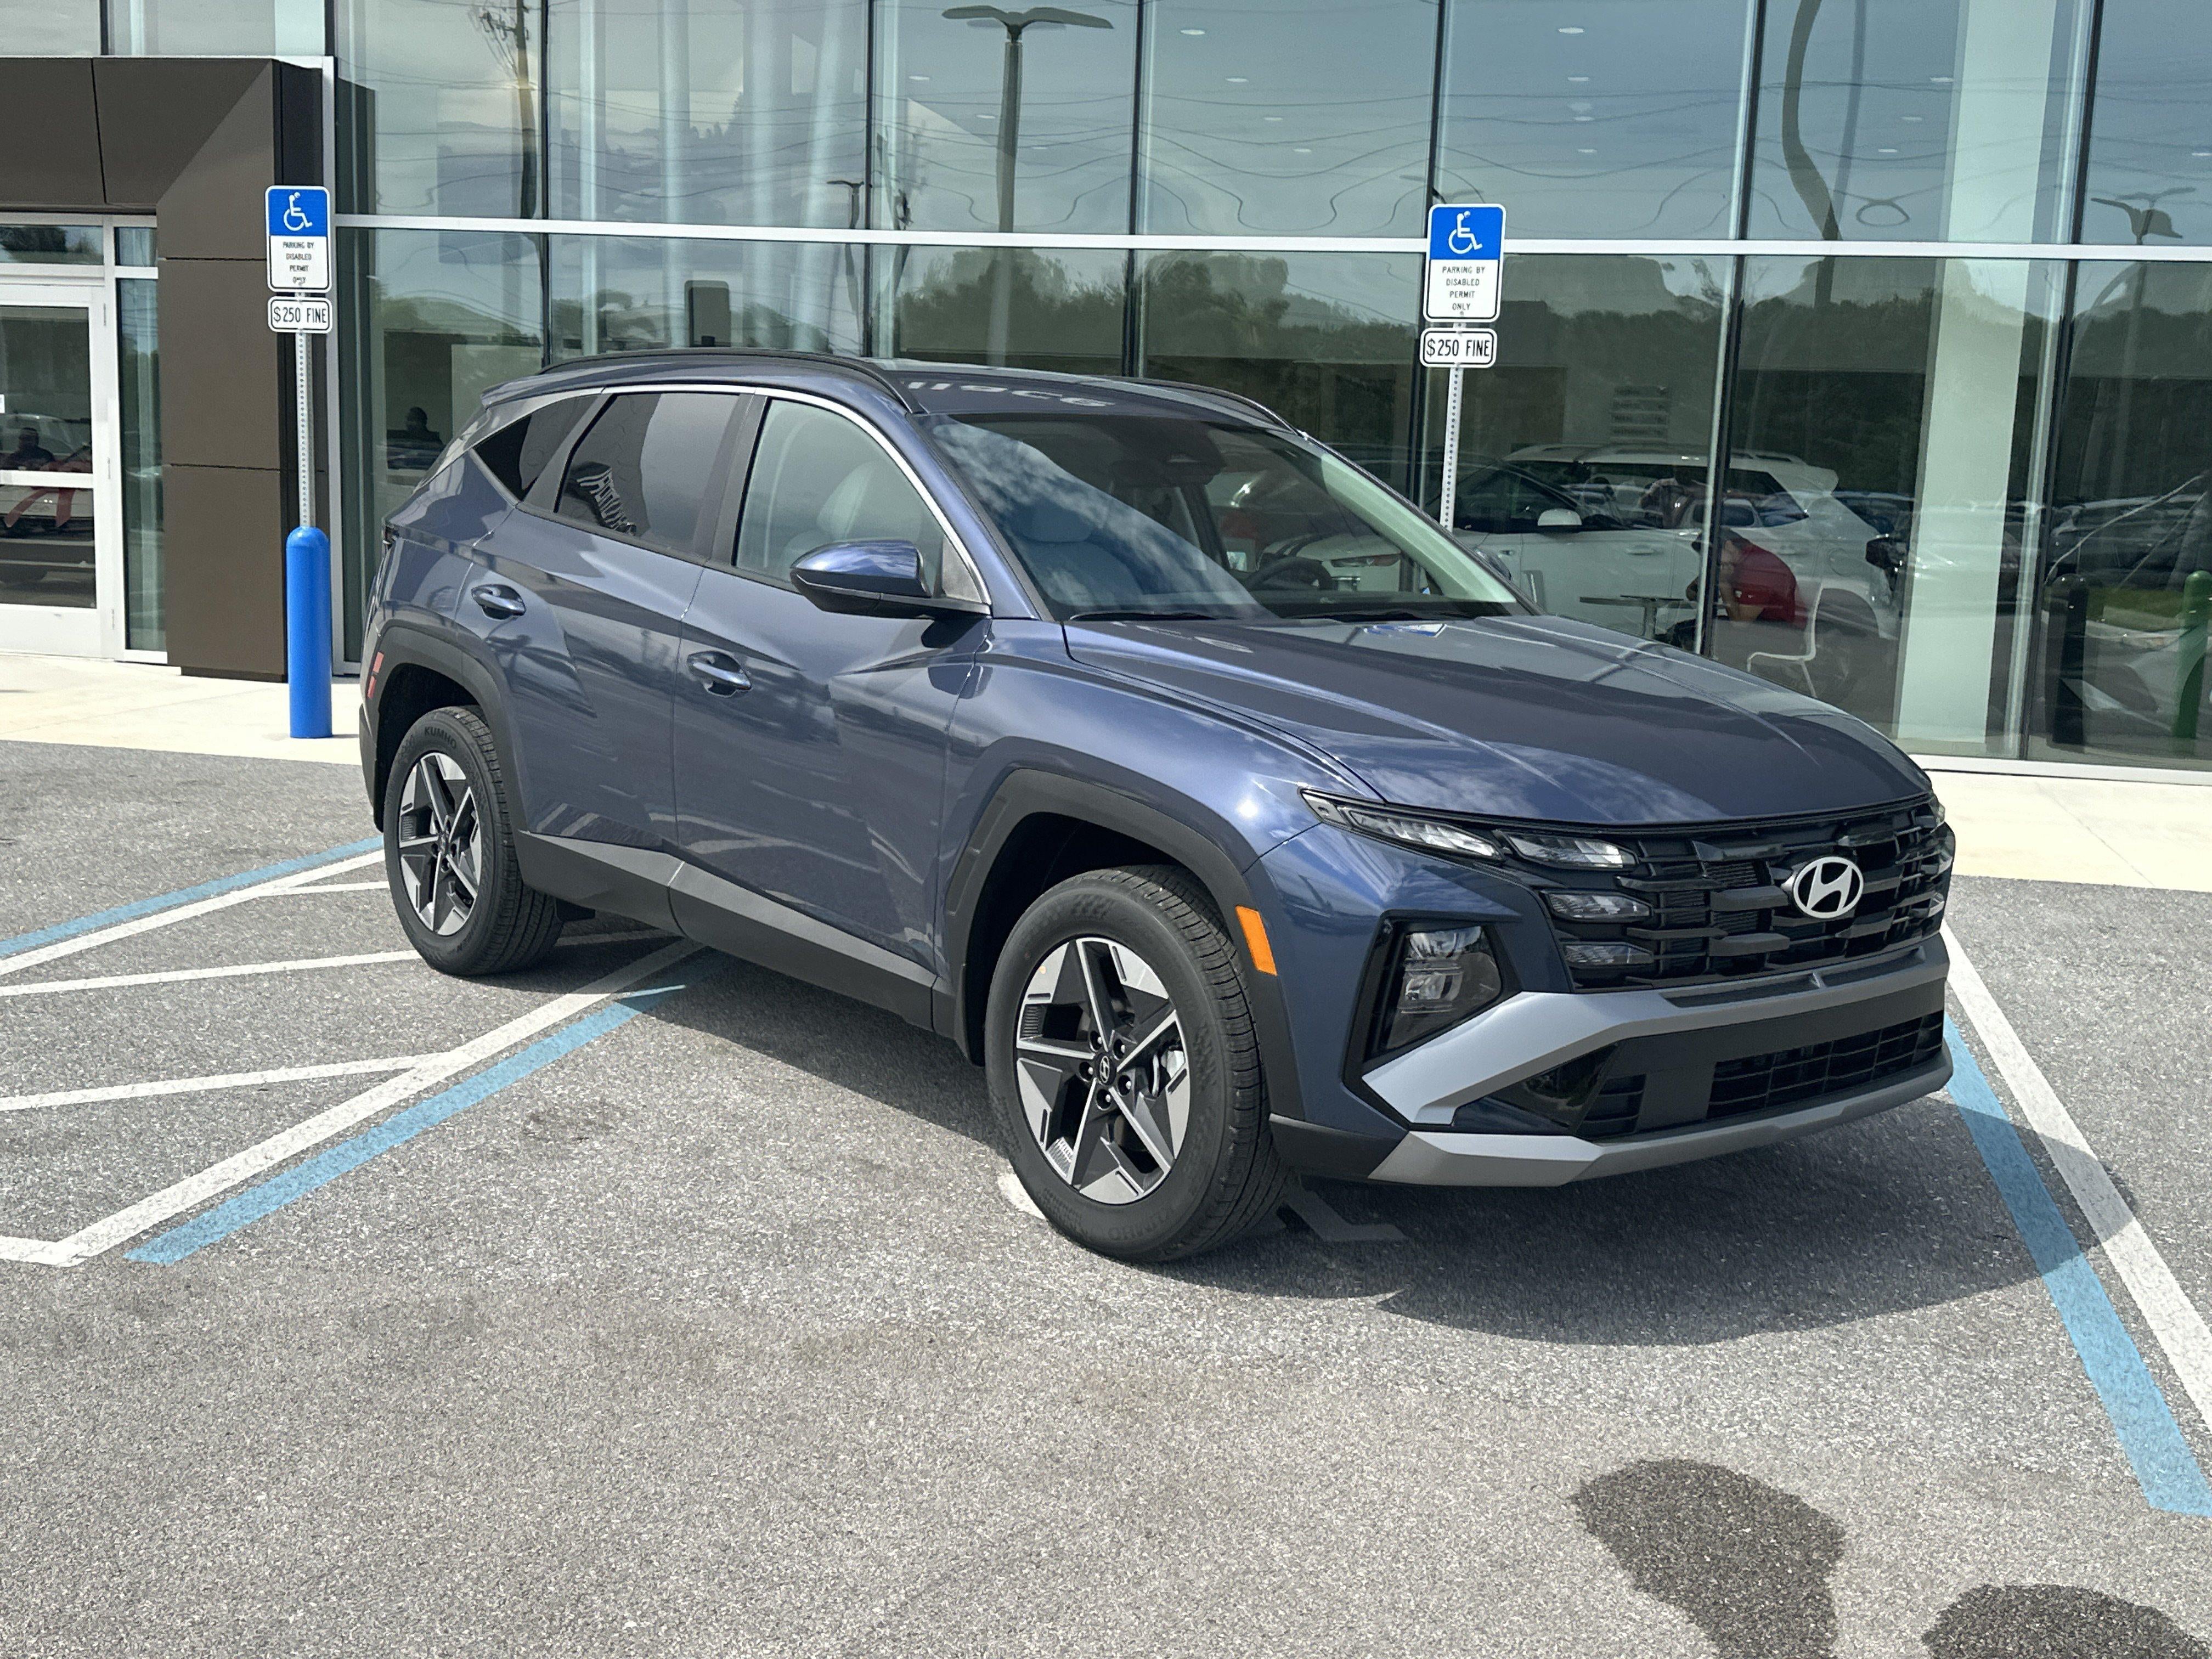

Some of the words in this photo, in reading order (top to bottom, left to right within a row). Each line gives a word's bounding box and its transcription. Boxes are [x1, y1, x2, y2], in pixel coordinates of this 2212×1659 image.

[273, 307, 301, 324] $250
[306, 307, 327, 324] FINE
[1426, 338, 1459, 357] $250
[1465, 339, 1490, 357] FINE
[424, 726, 457, 749] KUMHO
